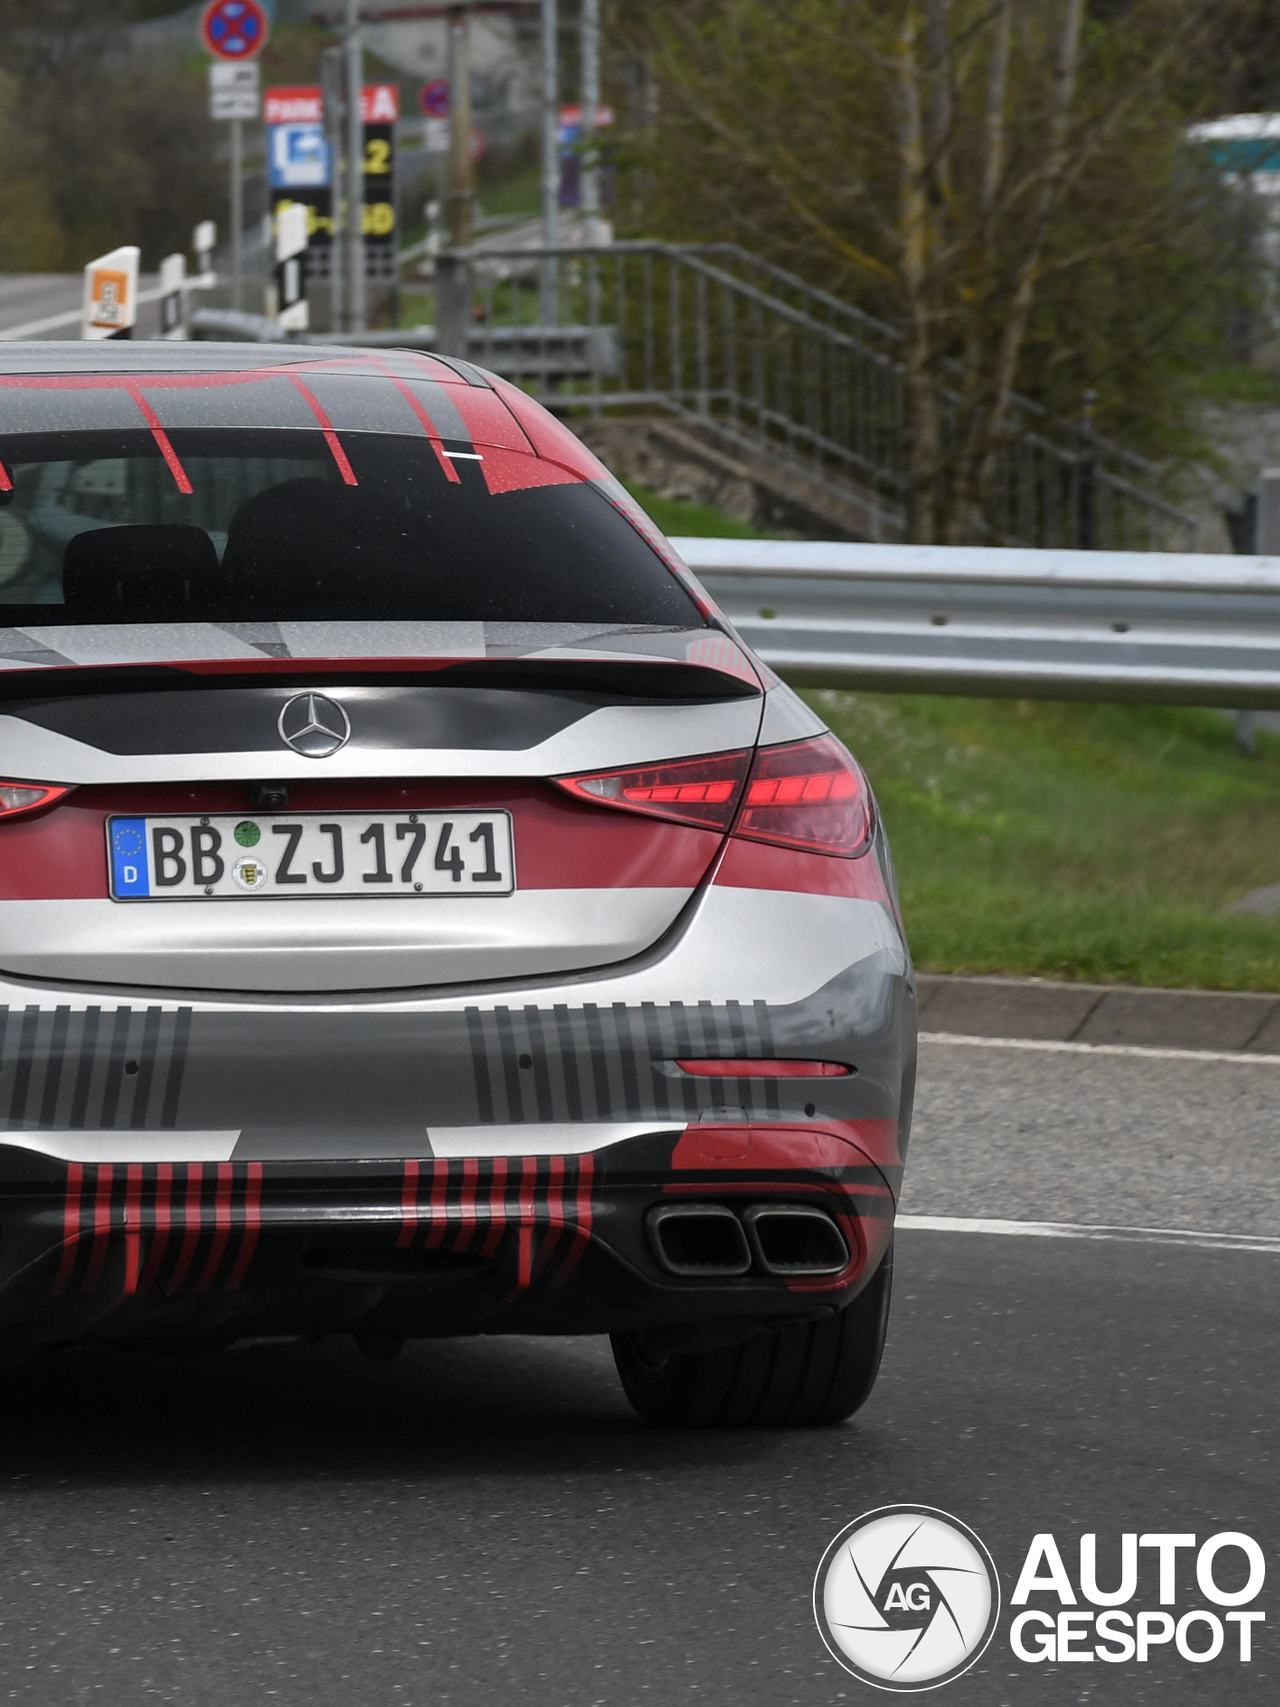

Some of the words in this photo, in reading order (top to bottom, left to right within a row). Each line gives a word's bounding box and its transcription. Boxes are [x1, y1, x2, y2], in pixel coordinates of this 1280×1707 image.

[123, 866, 138, 884] D
[153, 826, 224, 887] BB
[272, 824, 344, 885] ZJ
[360, 822, 502, 883] 1741
